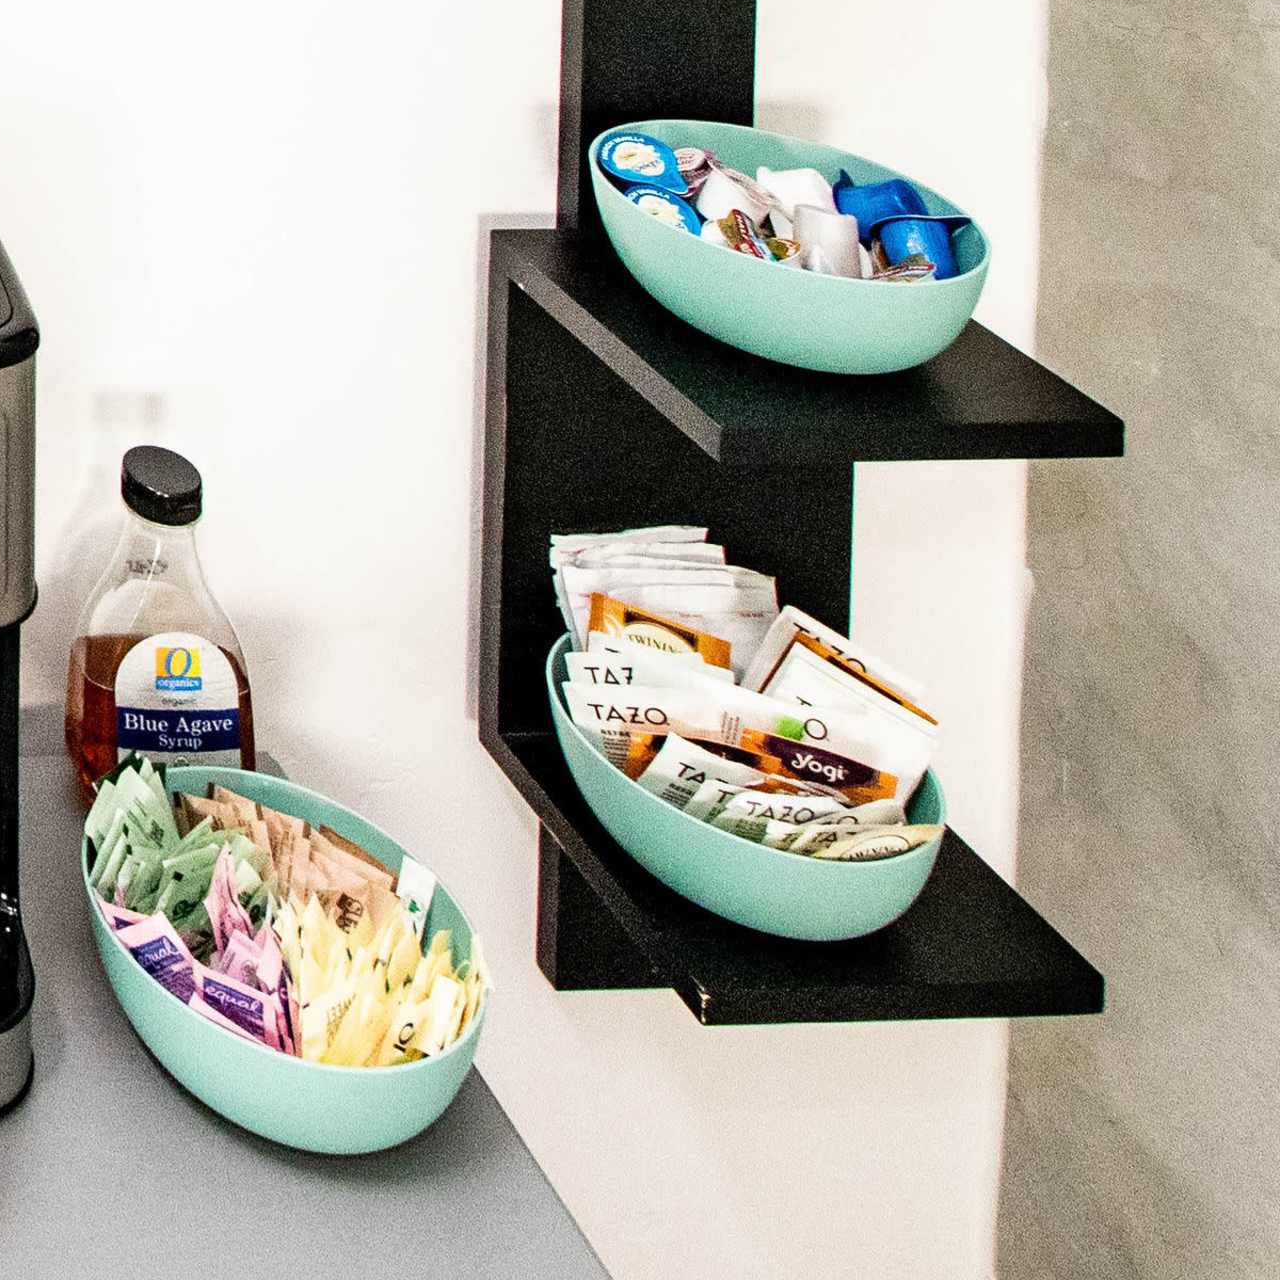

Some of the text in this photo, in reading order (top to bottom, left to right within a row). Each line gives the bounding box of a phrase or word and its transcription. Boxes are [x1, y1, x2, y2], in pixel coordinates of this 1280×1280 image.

[626, 634, 684, 654] TWININ
[124, 713, 234, 737] Blue Agave
[158, 733, 203, 749] Syrup
[791, 752, 845, 782] yogi
[746, 800, 816, 825] TAZO
[204, 984, 262, 1012] equal
